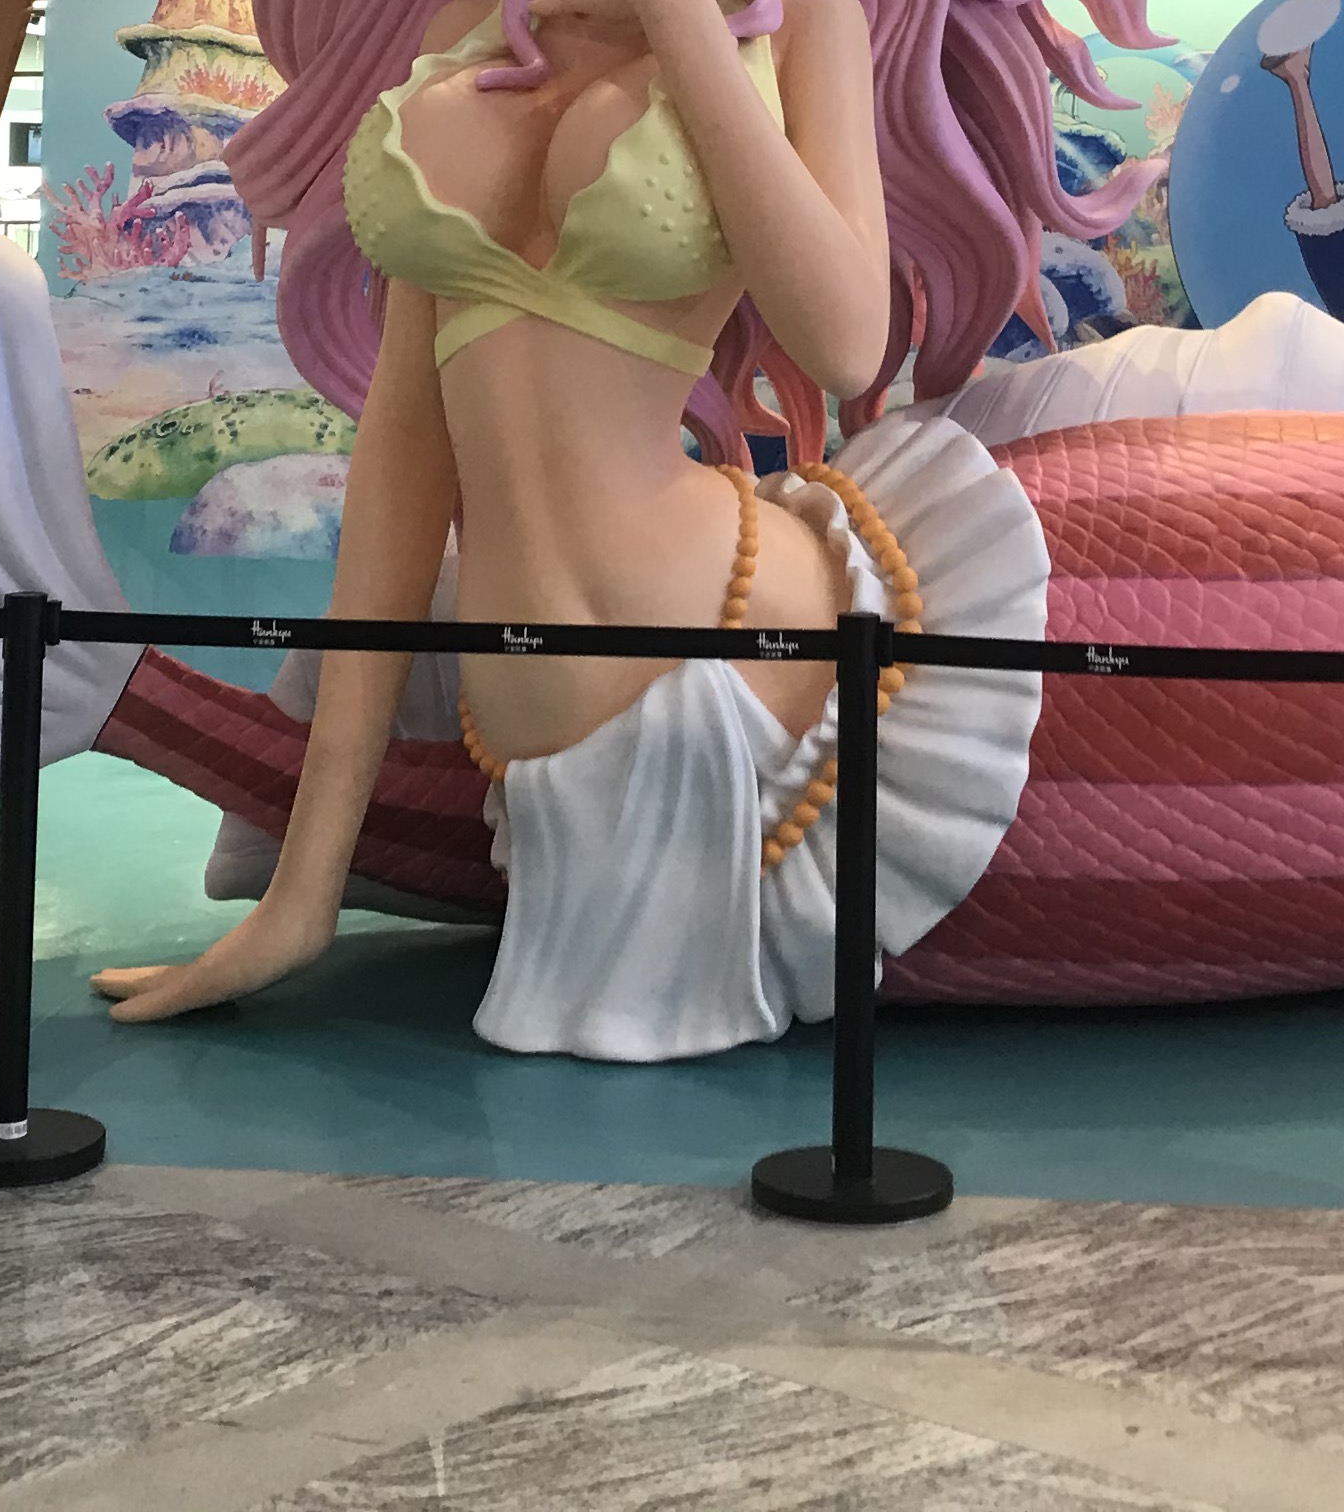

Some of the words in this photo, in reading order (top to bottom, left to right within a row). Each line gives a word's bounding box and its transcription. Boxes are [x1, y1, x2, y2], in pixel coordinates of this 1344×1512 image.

[251, 619, 292, 643] Hankyu
[501, 626, 544, 649] Hankyu
[756, 631, 800, 655] Hankyu
[1086, 645, 1130, 670] Hankyu
